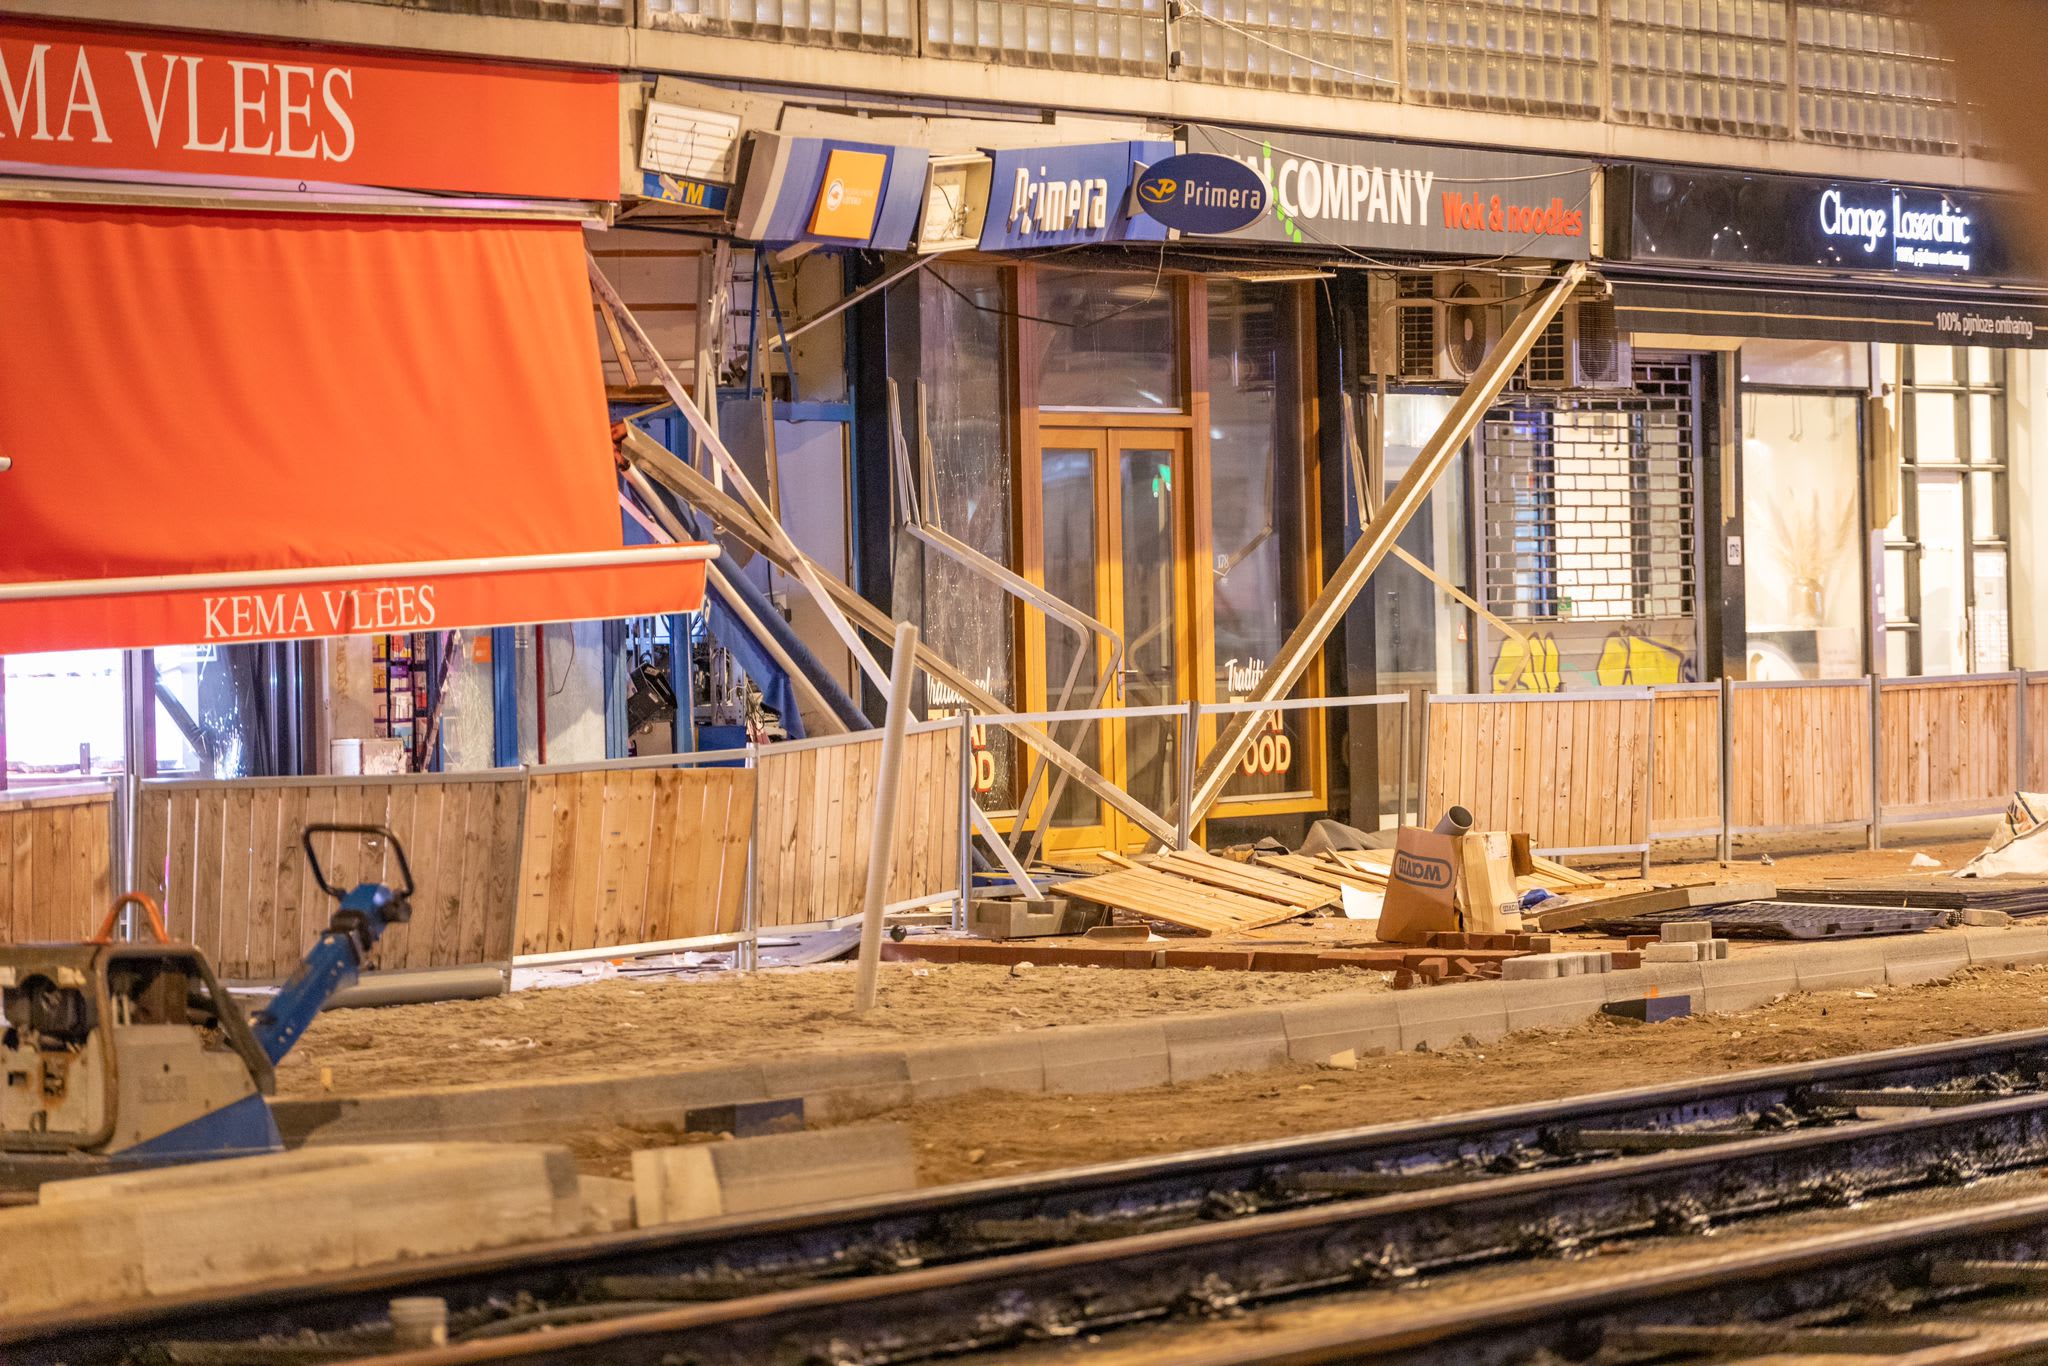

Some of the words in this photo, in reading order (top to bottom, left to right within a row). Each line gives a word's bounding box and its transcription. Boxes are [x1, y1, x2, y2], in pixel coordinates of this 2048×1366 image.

[0, 44, 113, 143] MA
[125, 50, 356, 163] VLEES
[1008, 165, 1108, 235] Primera
[1184, 180, 1261, 210] Primera
[1278, 159, 1434, 227] COMPANY
[1442, 191, 1486, 231] Wok
[1489, 194, 1504, 232] &
[1507, 197, 1583, 237] noodles
[1820, 189, 1887, 253] Change
[1893, 194, 1971, 245] Laserclinic
[1936, 311, 1961, 332] 100%
[1962, 312, 1994, 337] pijnloze
[1995, 315, 2033, 340] ontharing
[203, 593, 315, 639] KEMA
[321, 584, 436, 631] VLEES
[1225, 656, 1268, 692] Traditi
[1242, 735, 1291, 775] OOD
